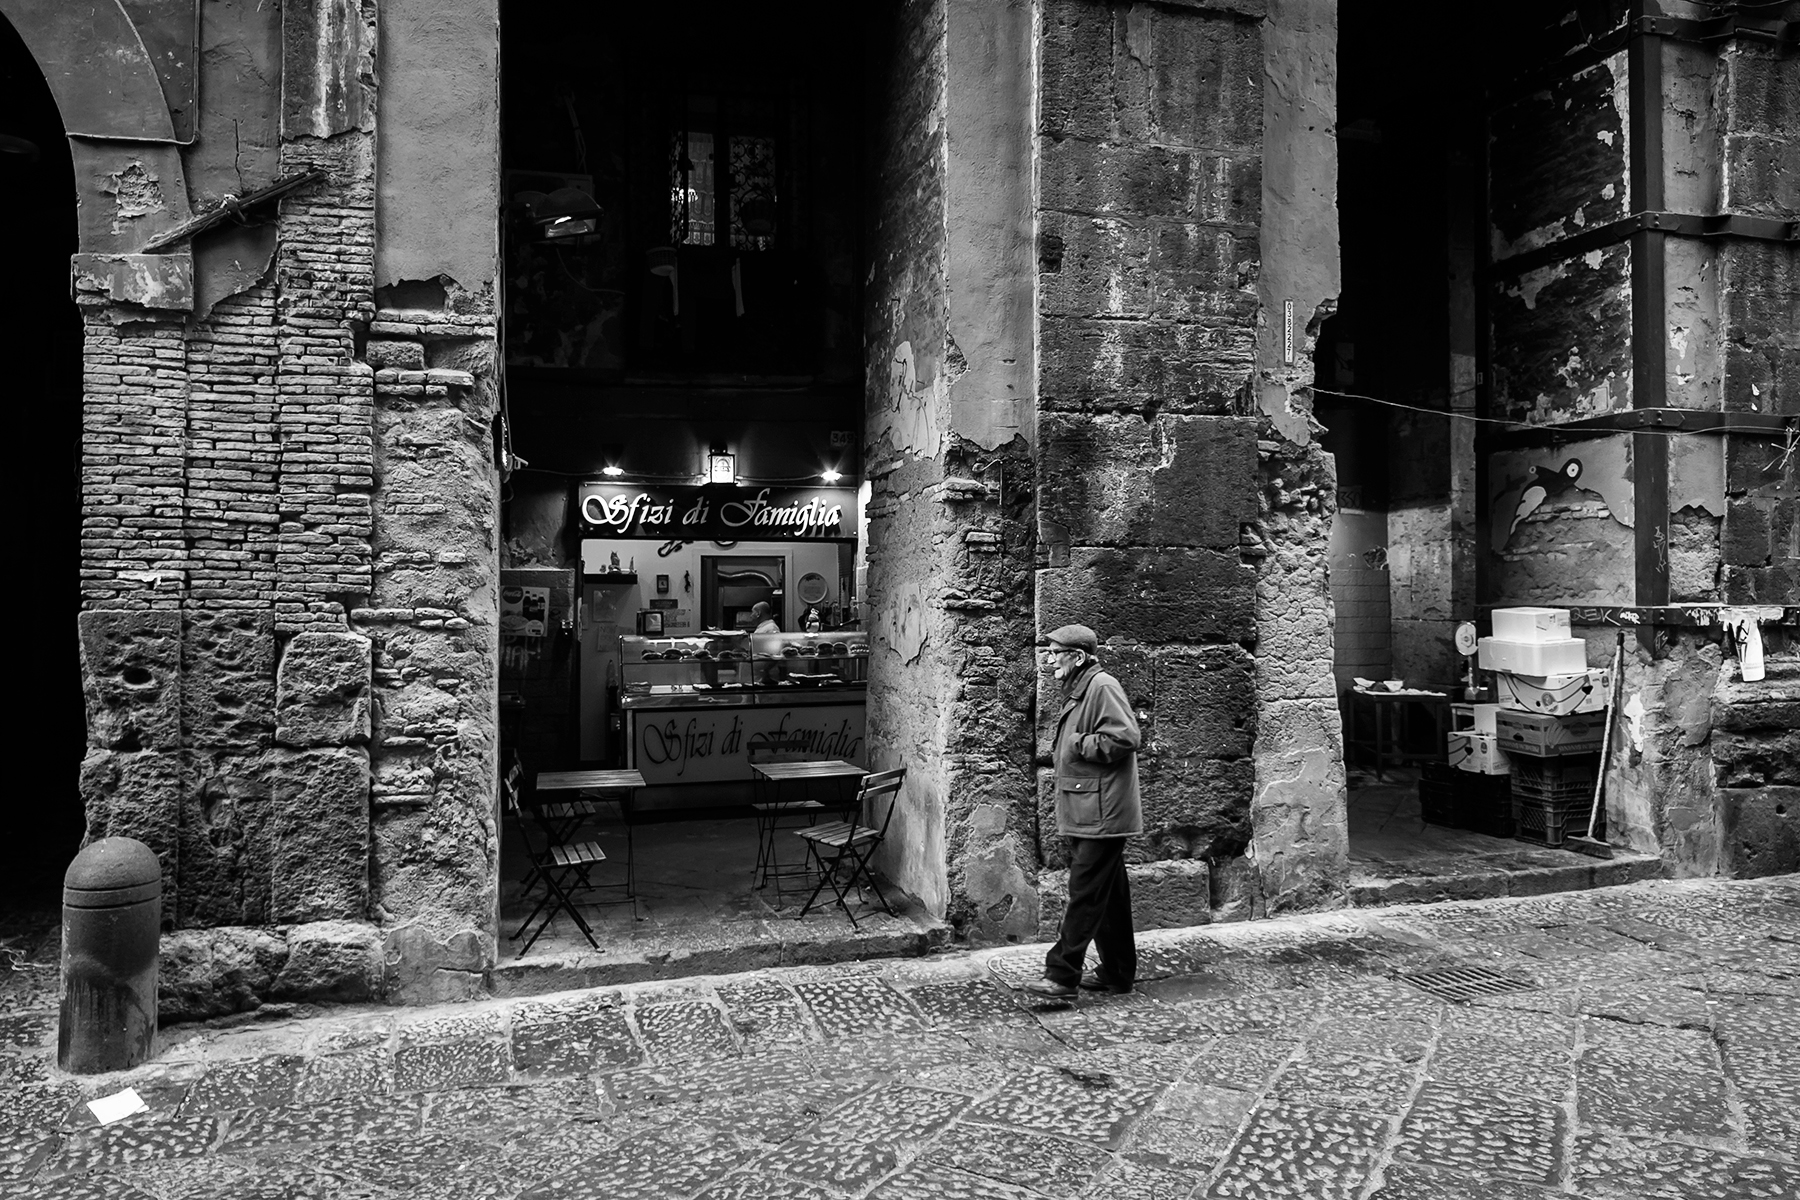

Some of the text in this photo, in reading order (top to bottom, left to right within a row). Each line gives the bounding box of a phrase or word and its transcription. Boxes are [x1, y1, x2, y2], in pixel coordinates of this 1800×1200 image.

[832, 432, 854, 444] 349
[582, 488, 842, 536] Sfizi di Famiglia
[1340, 491, 1361, 509] 350
[643, 718, 716, 776] Sfizi
[721, 715, 744, 756] di
